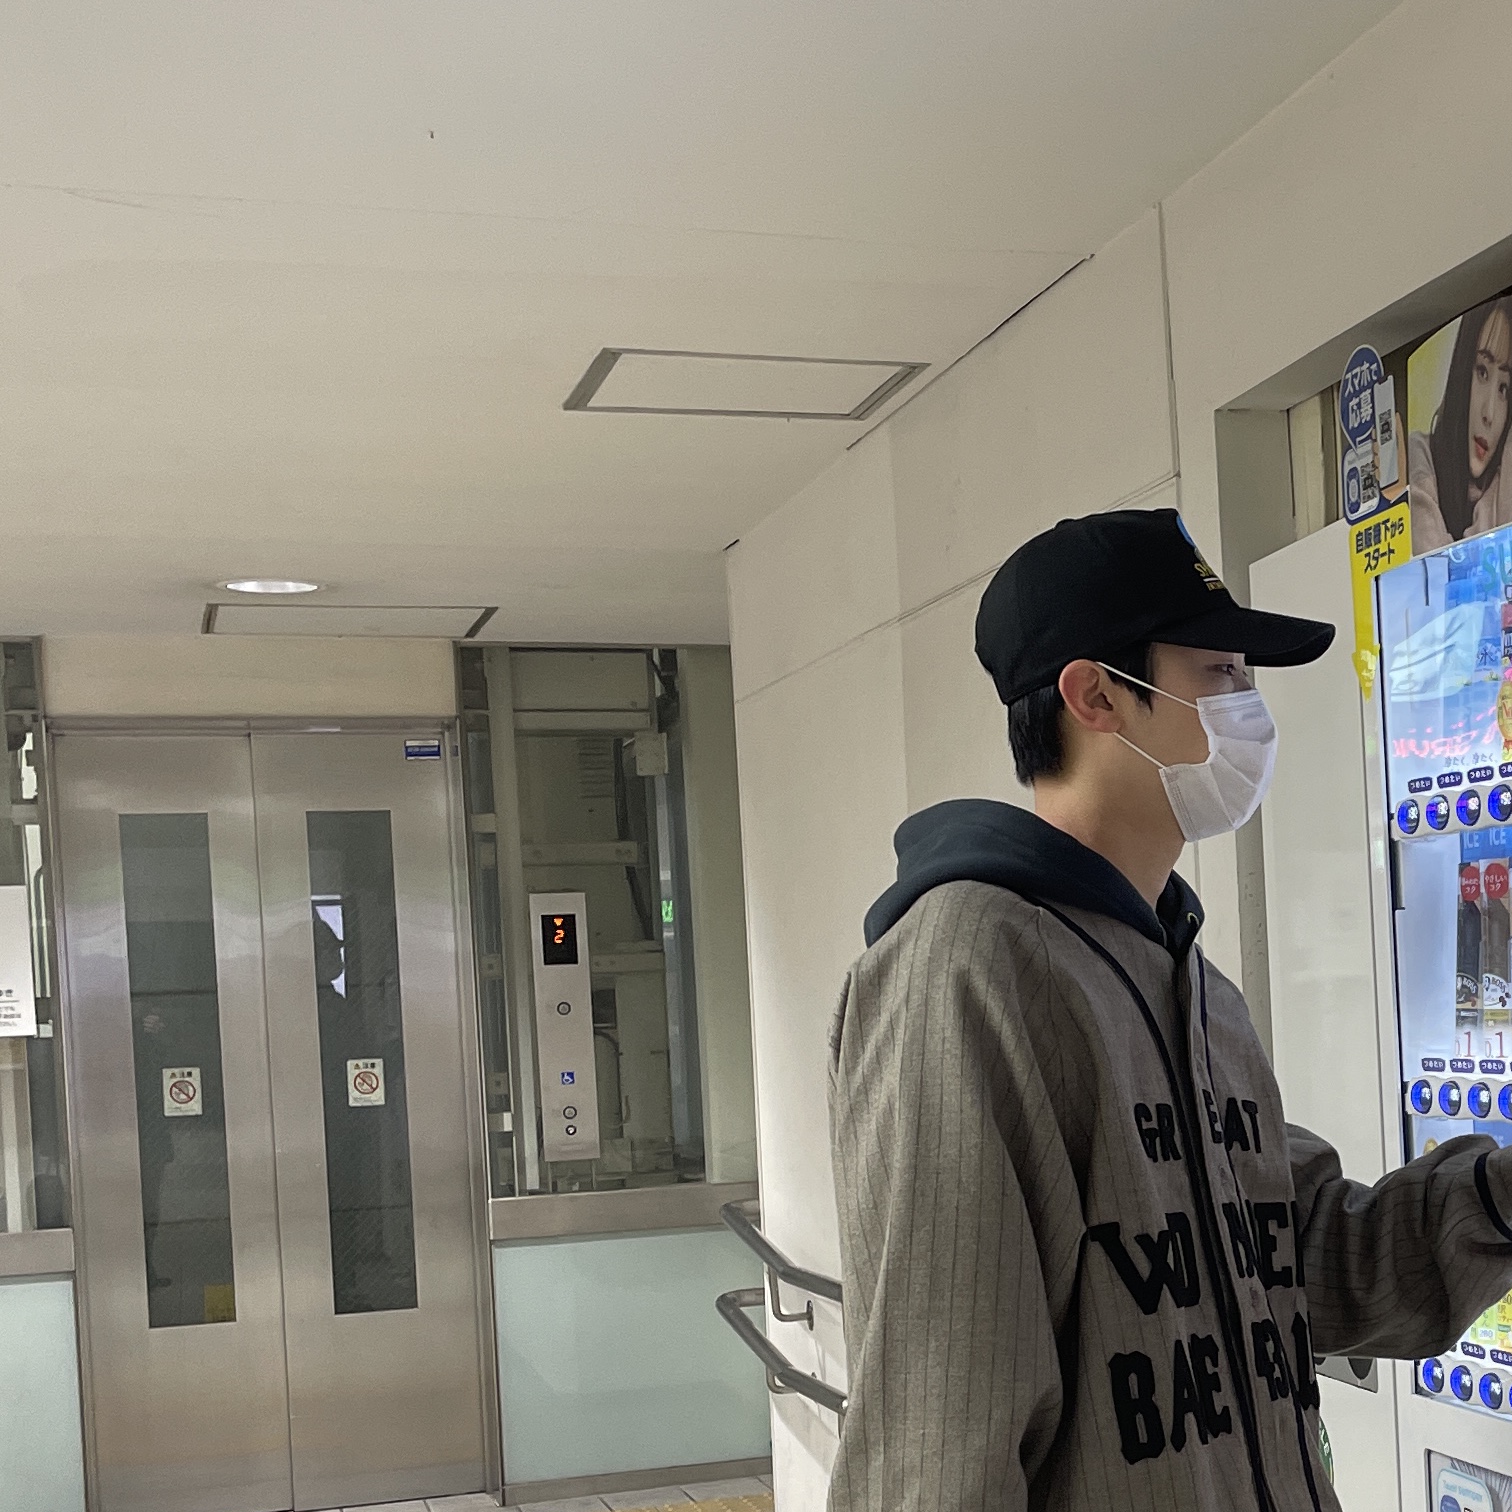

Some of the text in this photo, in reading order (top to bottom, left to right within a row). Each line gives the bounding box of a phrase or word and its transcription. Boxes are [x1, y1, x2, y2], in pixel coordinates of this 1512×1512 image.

[1344, 360, 1377, 394] スマホで
[1349, 389, 1373, 429] 応募
[1364, 547, 1395, 573] スタート
[554, 930, 564, 943] 2
